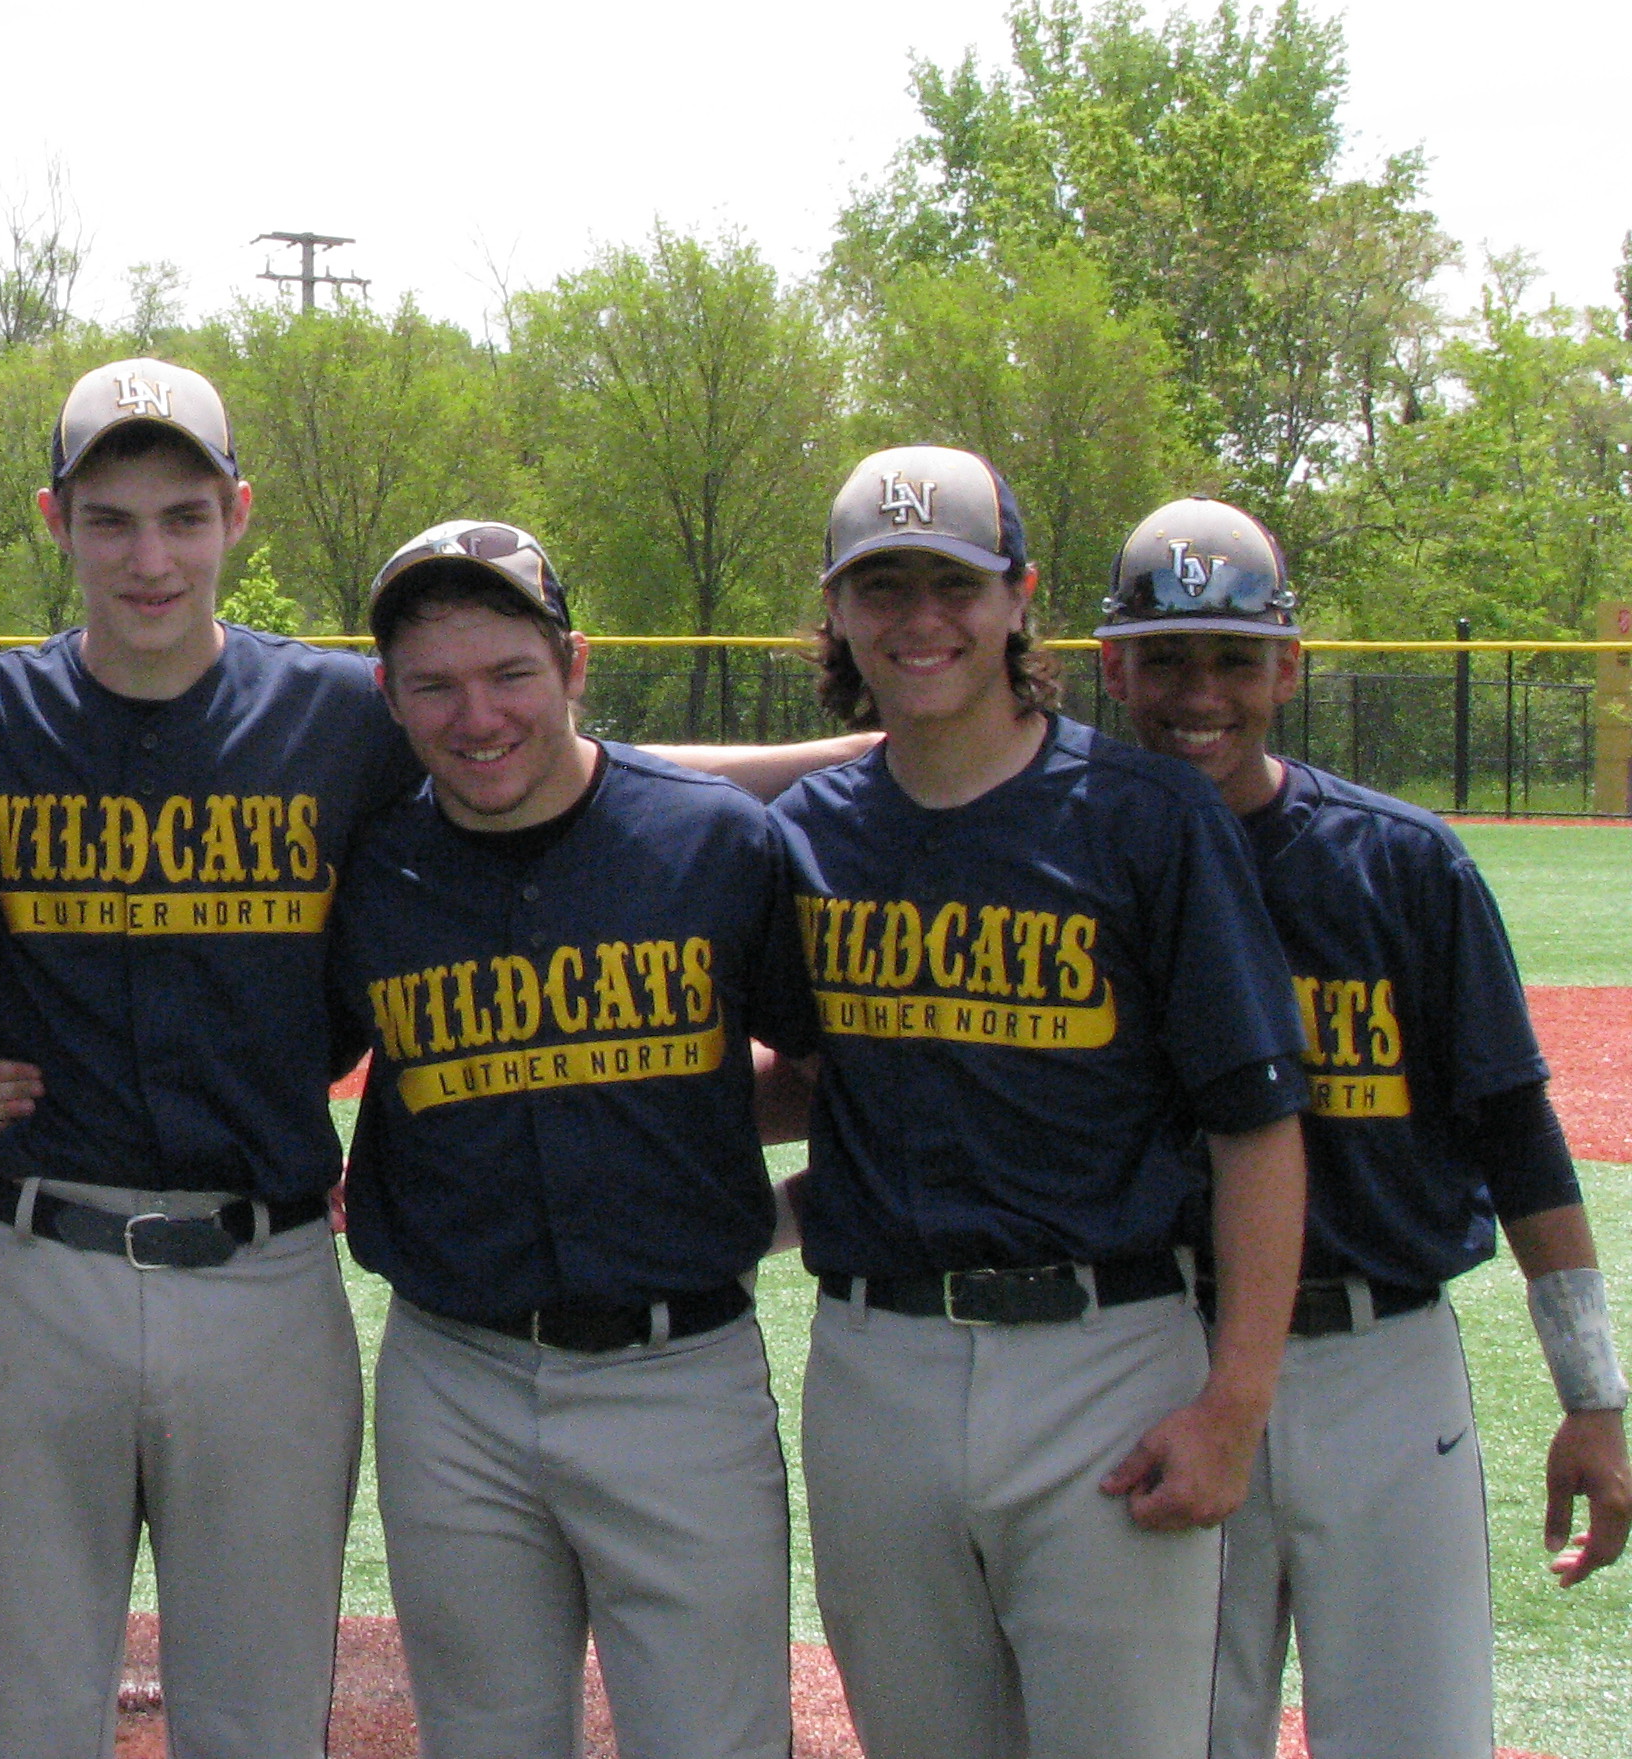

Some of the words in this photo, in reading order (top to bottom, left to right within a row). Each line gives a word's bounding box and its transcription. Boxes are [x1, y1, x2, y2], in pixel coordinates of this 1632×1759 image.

[114, 371, 172, 418] LN
[878, 471, 938, 525] LN
[32, 900, 167, 929] LUTHER
[193, 899, 302, 926] NORTH
[795, 895, 1097, 1002] WILDCATS
[369, 936, 713, 1062] WILDCATS
[956, 1005, 1068, 1041] NORTH
[437, 1051, 568, 1096] LUTHER
[591, 1042, 699, 1076] NORTH
